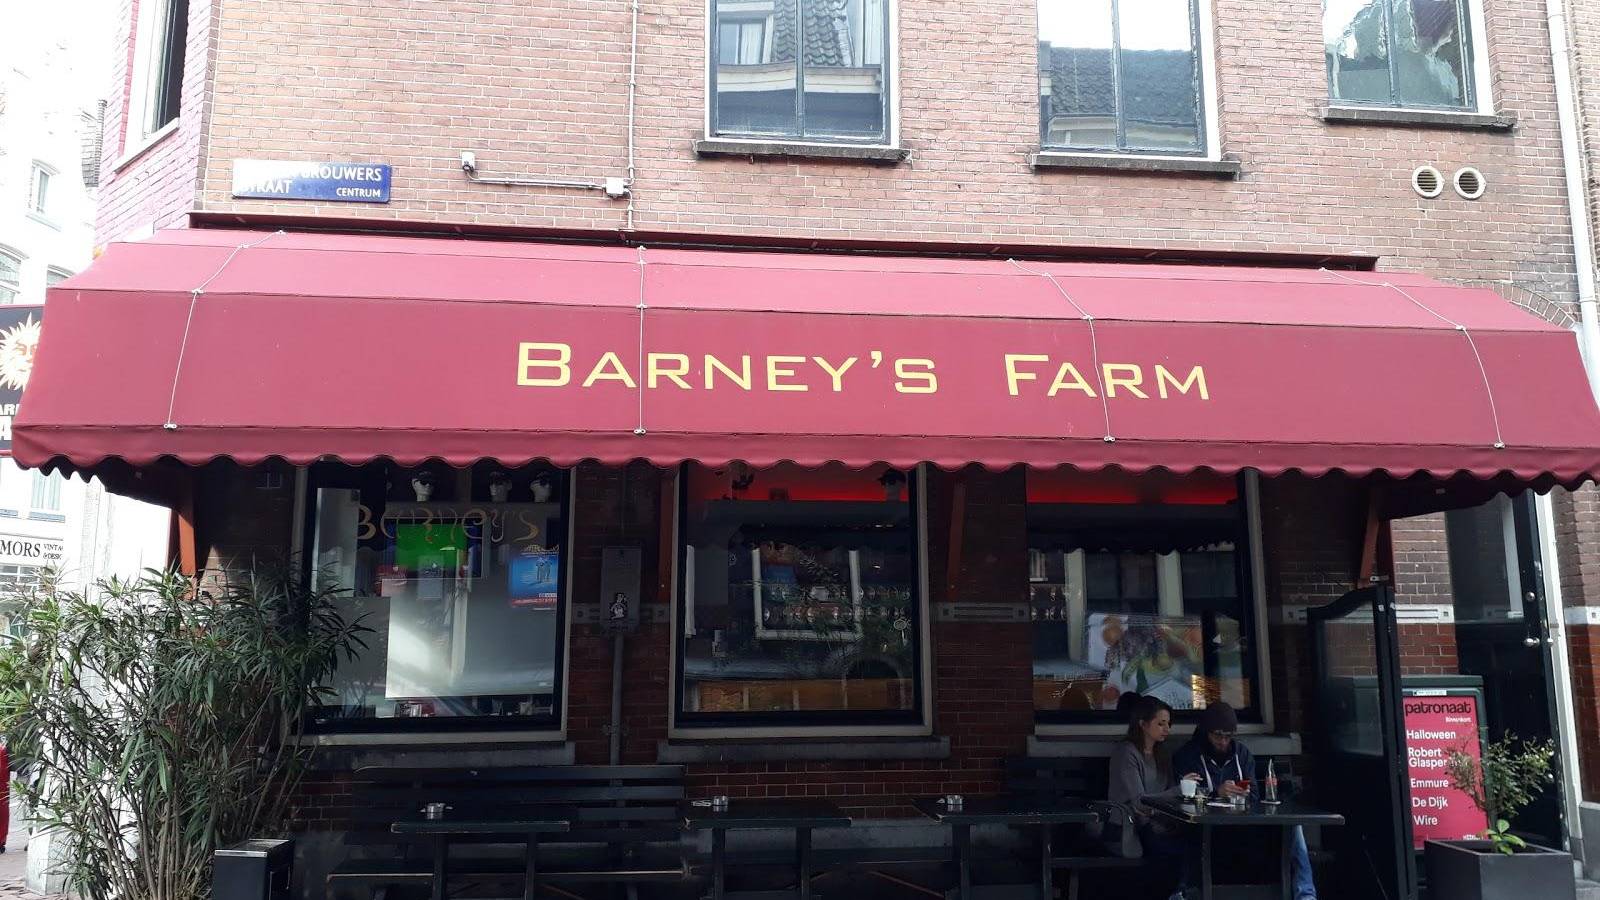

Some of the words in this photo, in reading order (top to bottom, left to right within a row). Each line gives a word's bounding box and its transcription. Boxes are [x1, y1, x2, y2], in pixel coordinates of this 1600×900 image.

[336, 187, 381, 198] CENTRUM
[516, 341, 939, 395] BARNEY'S
[1004, 353, 1210, 400] FARM
[1405, 701, 1472, 717] patronaat
[1406, 729, 1456, 740] Halloween
[1407, 747, 1442, 758] Robert
[1408, 757, 1448, 770] Glasper
[1410, 778, 1449, 788] Emmure
[1412, 797, 1427, 808] De
[1428, 796, 1449, 810] Dijk
[1413, 814, 1438, 826] Wire
